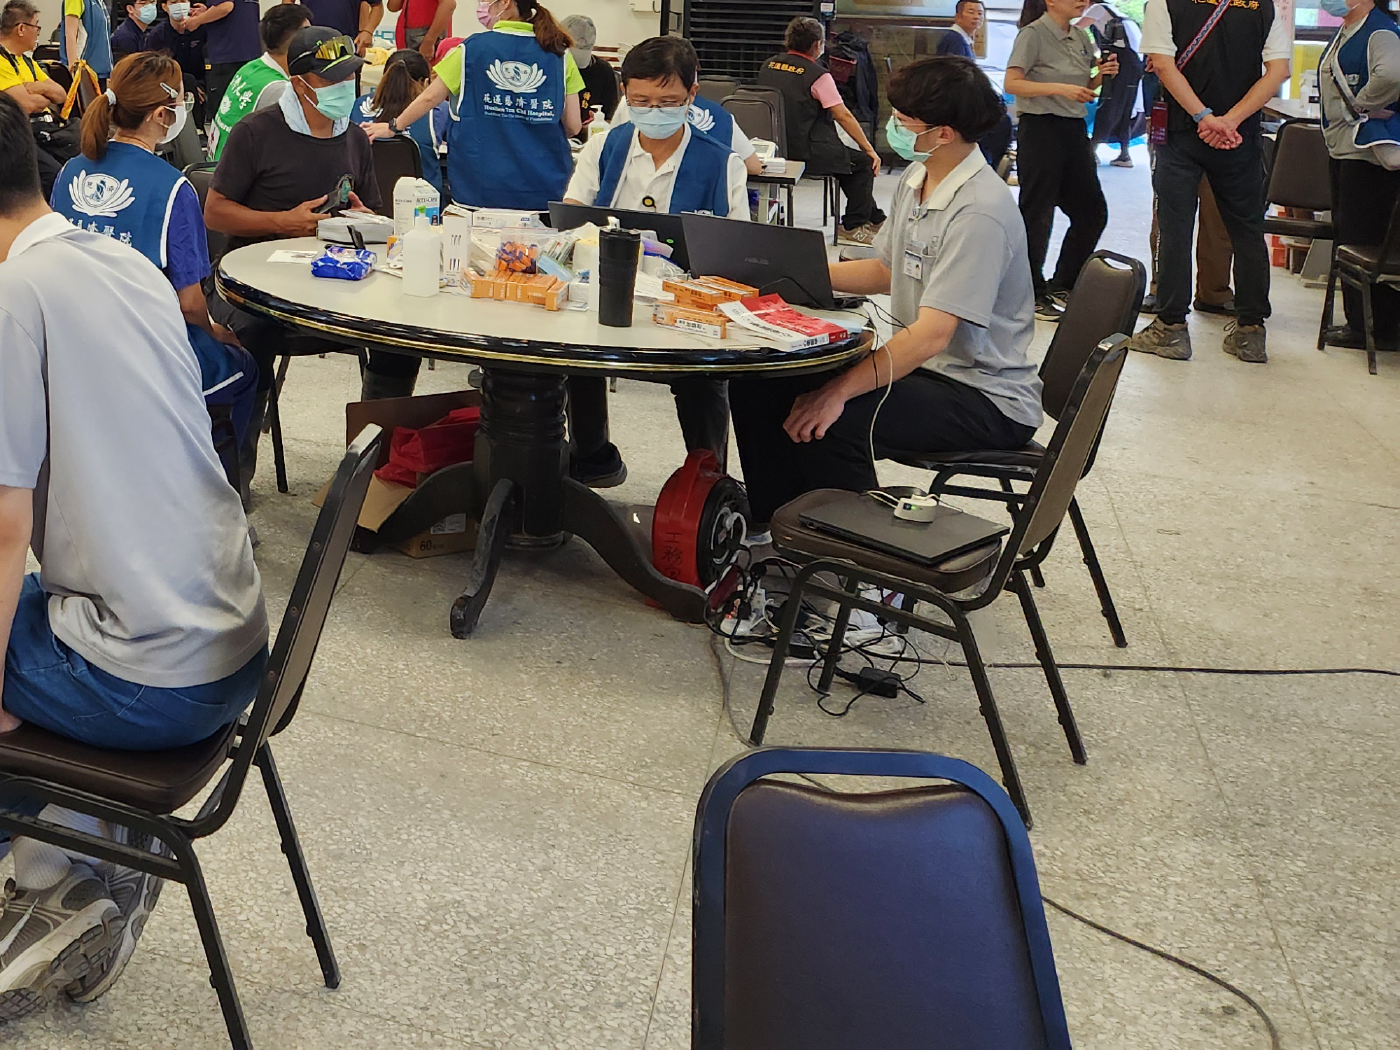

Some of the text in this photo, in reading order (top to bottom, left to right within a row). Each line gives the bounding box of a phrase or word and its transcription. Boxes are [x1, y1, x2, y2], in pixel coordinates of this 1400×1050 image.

[483, 93, 555, 110] 花蓮慈濟醫院
